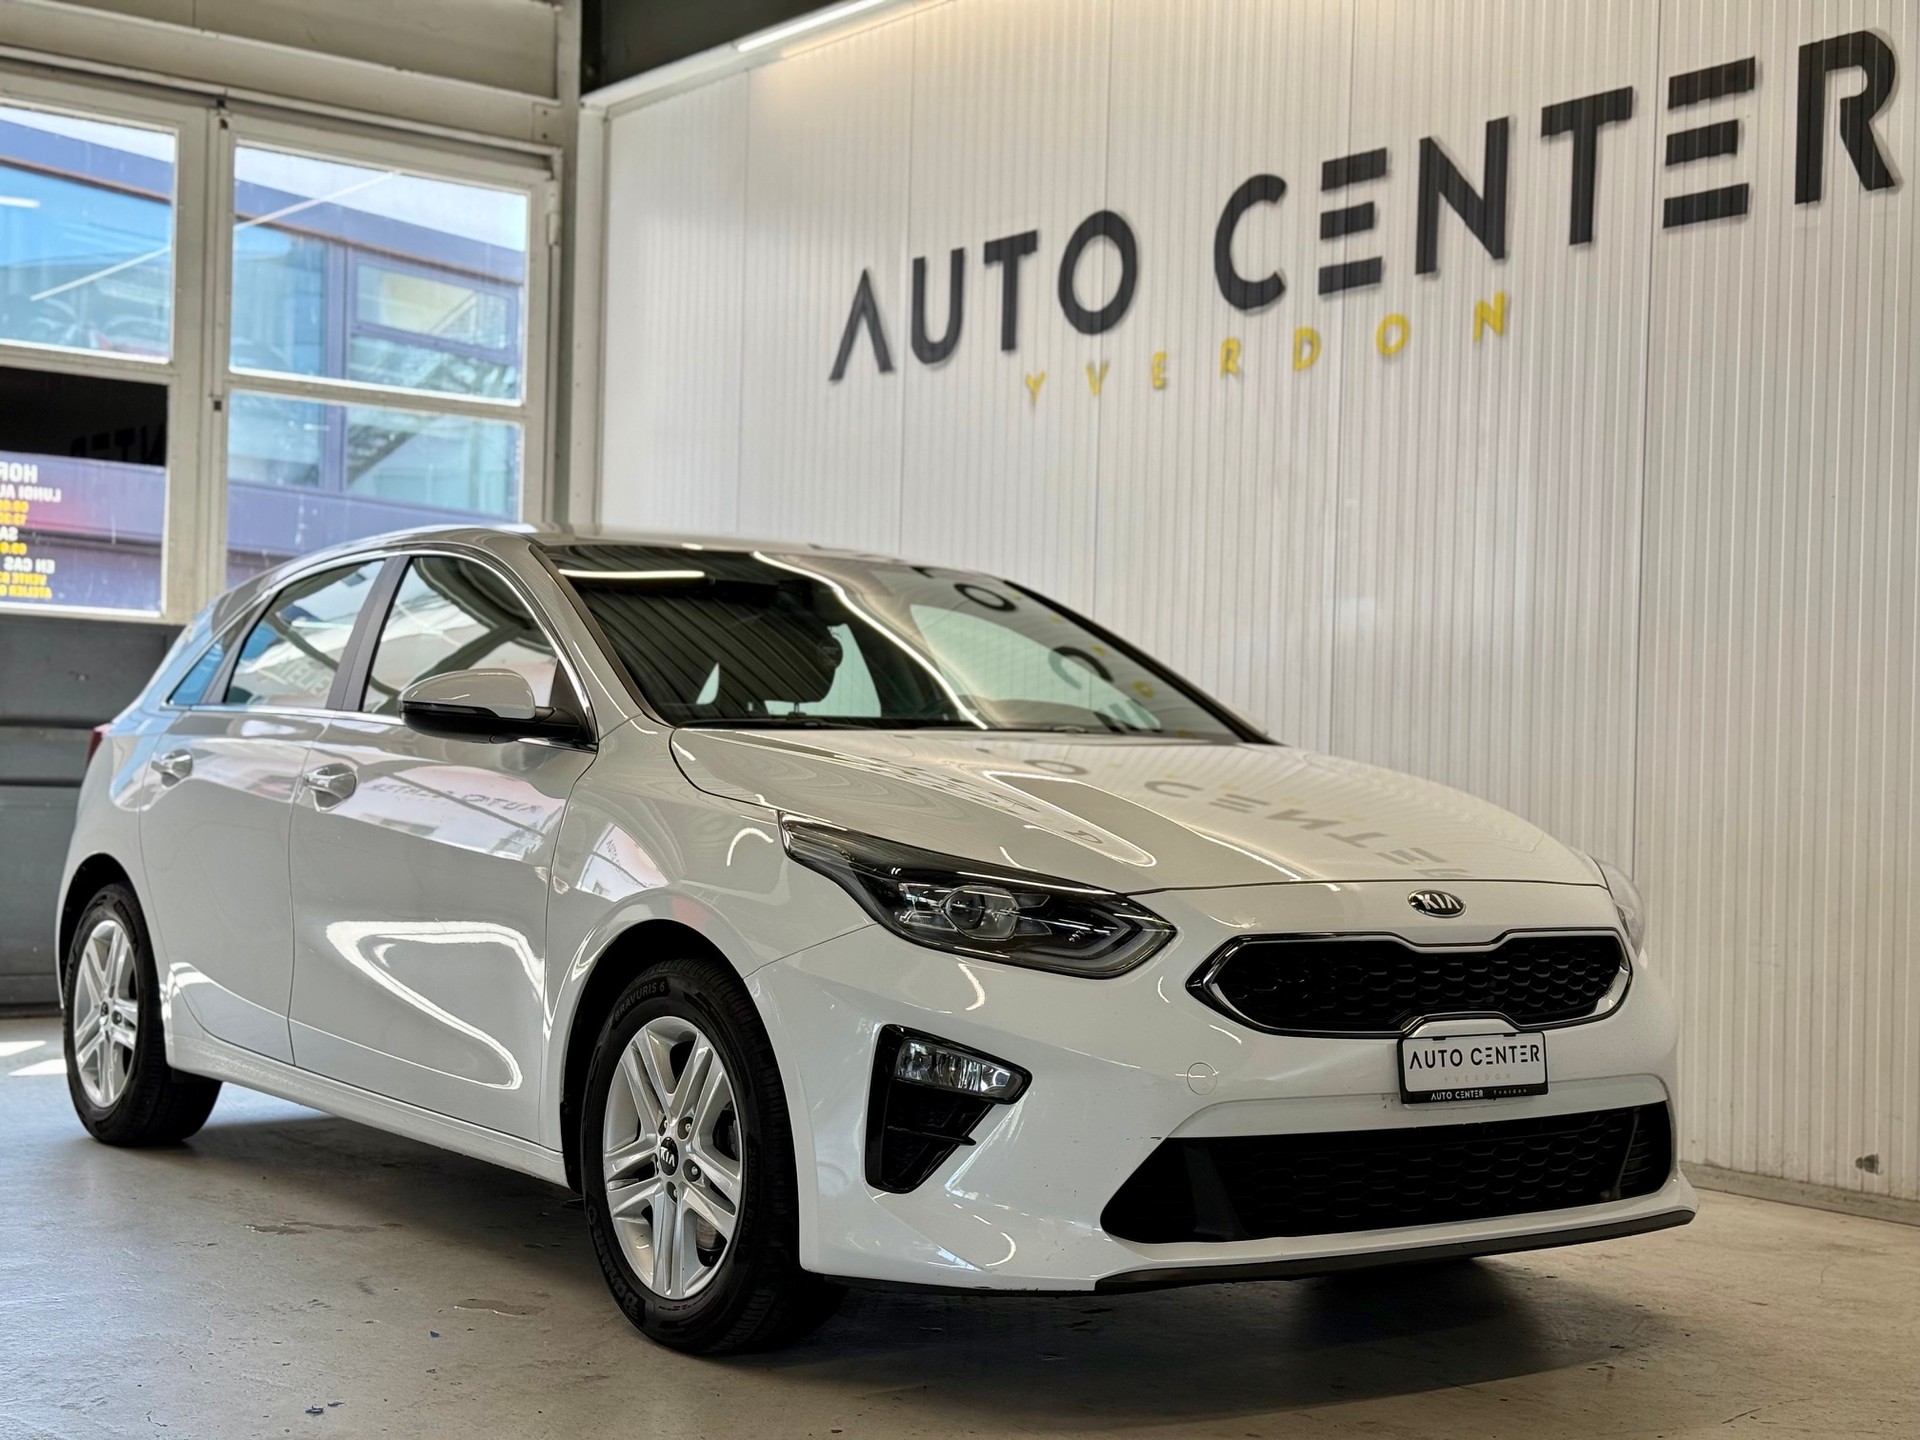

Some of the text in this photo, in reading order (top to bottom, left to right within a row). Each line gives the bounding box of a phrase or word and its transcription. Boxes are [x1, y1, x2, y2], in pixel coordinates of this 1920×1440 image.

[829, 30, 1899, 381] AUTO CENTER
[1025, 291, 1507, 407] YVERDON
[614, 981, 665, 1021] BRAVURIS 6
[1409, 1044, 1540, 1070] AUTO CENTER
[1430, 1091, 1453, 1101] AUTO
[1454, 1089, 1484, 1099] CENTER
[660, 1146, 676, 1168] KIA
